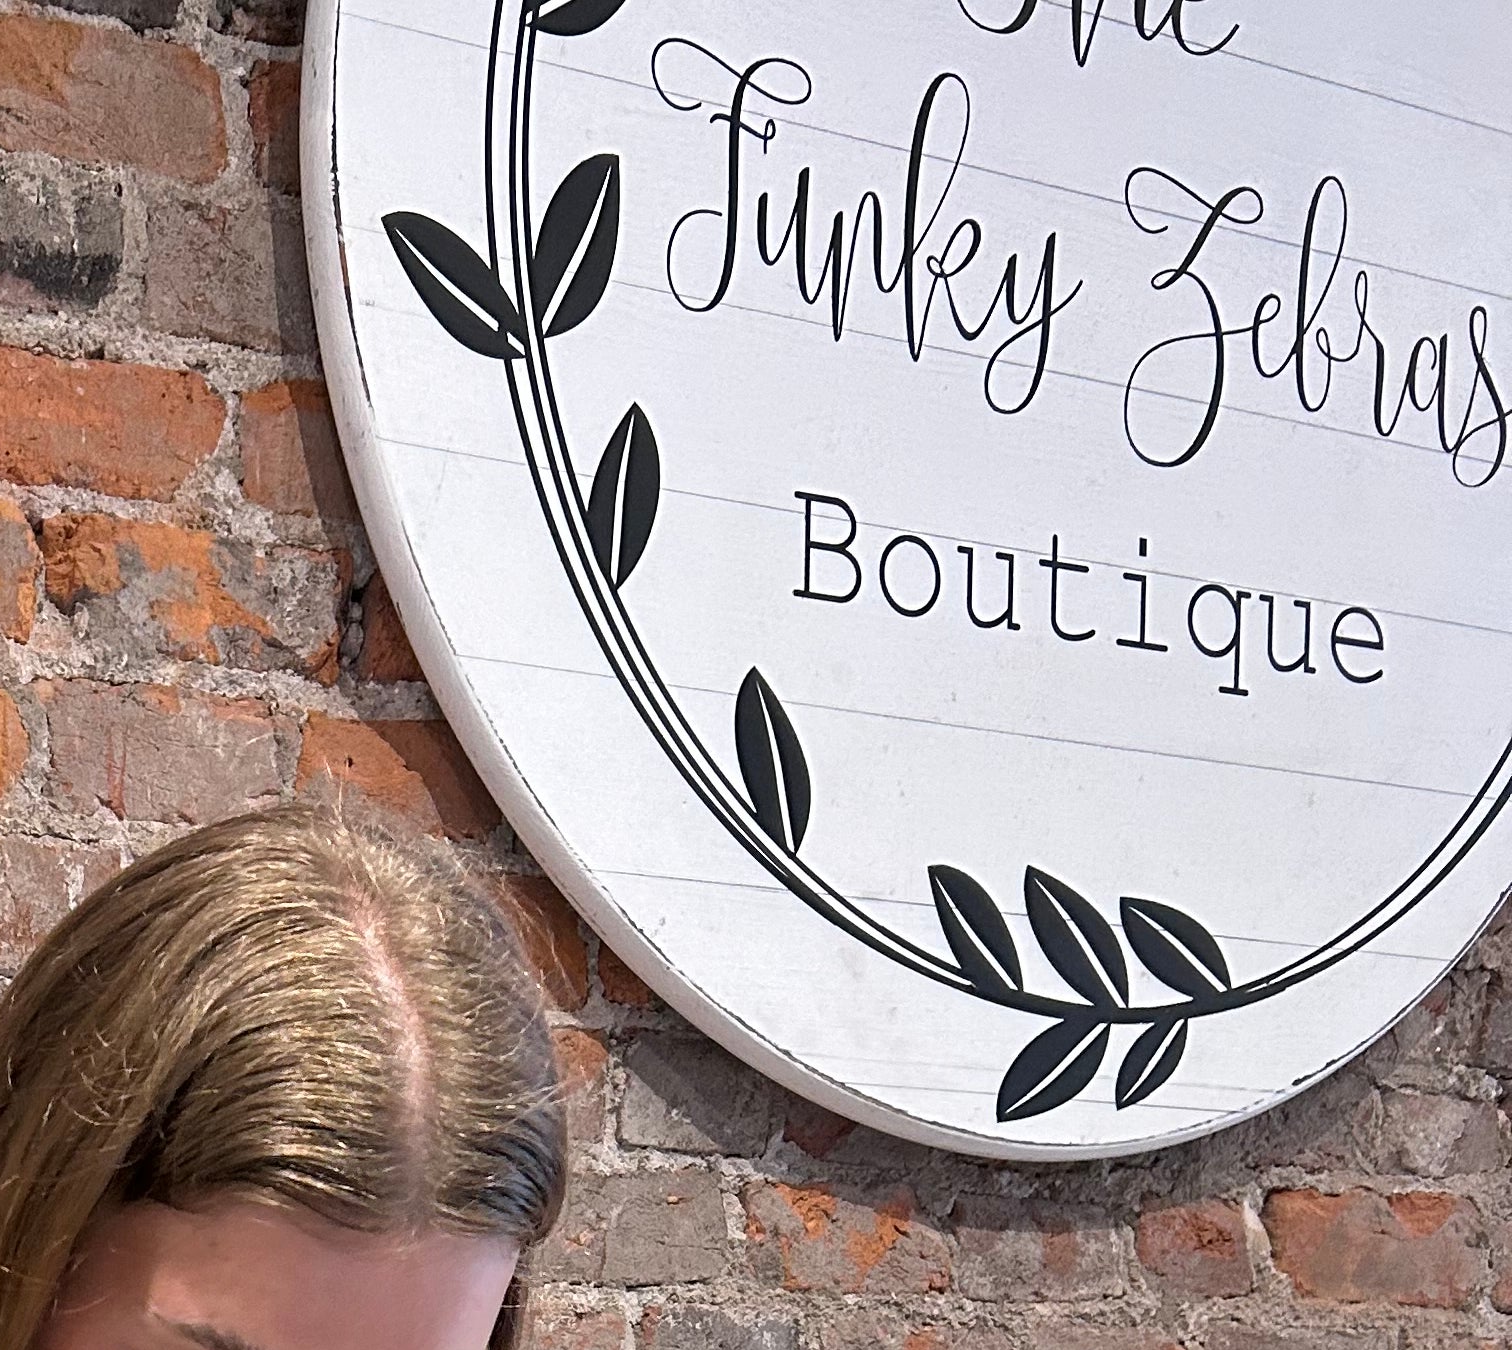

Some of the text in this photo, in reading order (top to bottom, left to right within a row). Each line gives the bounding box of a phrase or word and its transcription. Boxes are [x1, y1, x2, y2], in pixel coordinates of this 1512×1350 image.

[651, 37, 1512, 488] Funky Zebras
[792, 490, 1385, 697] Boutique
